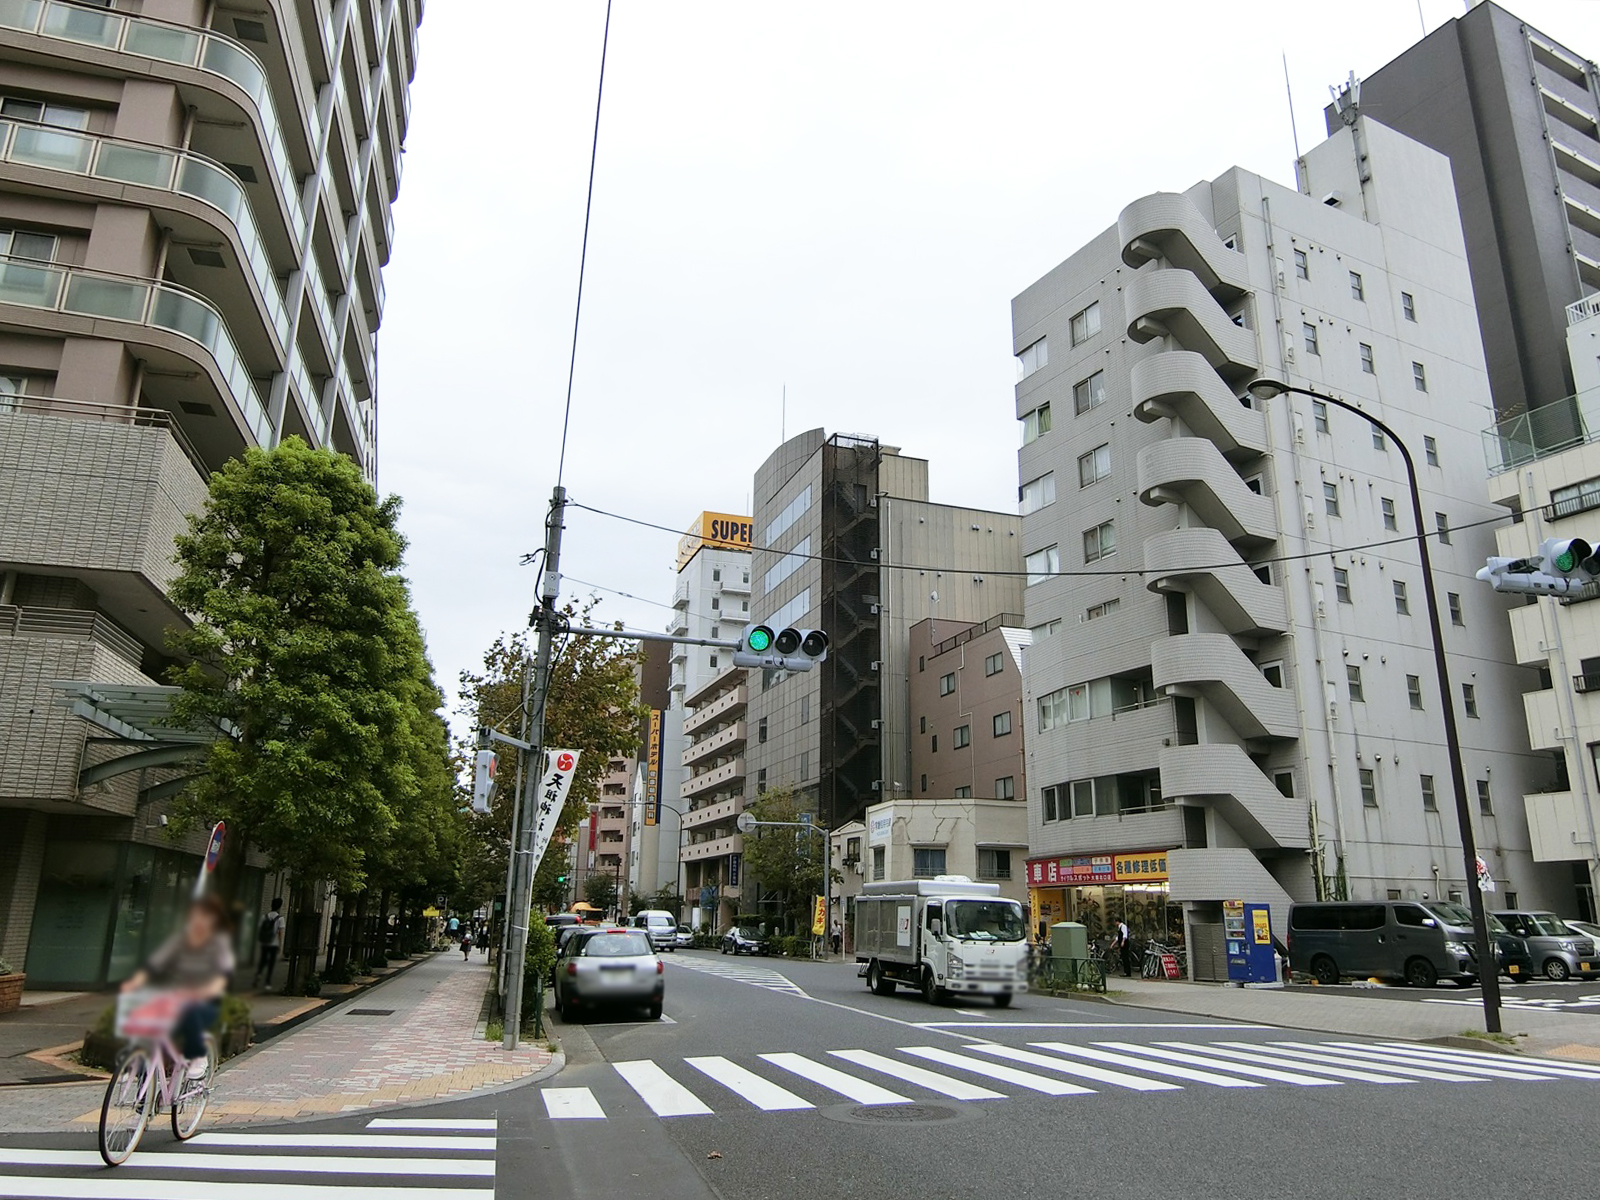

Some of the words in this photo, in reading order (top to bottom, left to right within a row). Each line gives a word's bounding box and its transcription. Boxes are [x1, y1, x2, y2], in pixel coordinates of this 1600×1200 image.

[650, 714, 659, 765] スーパーホテル
